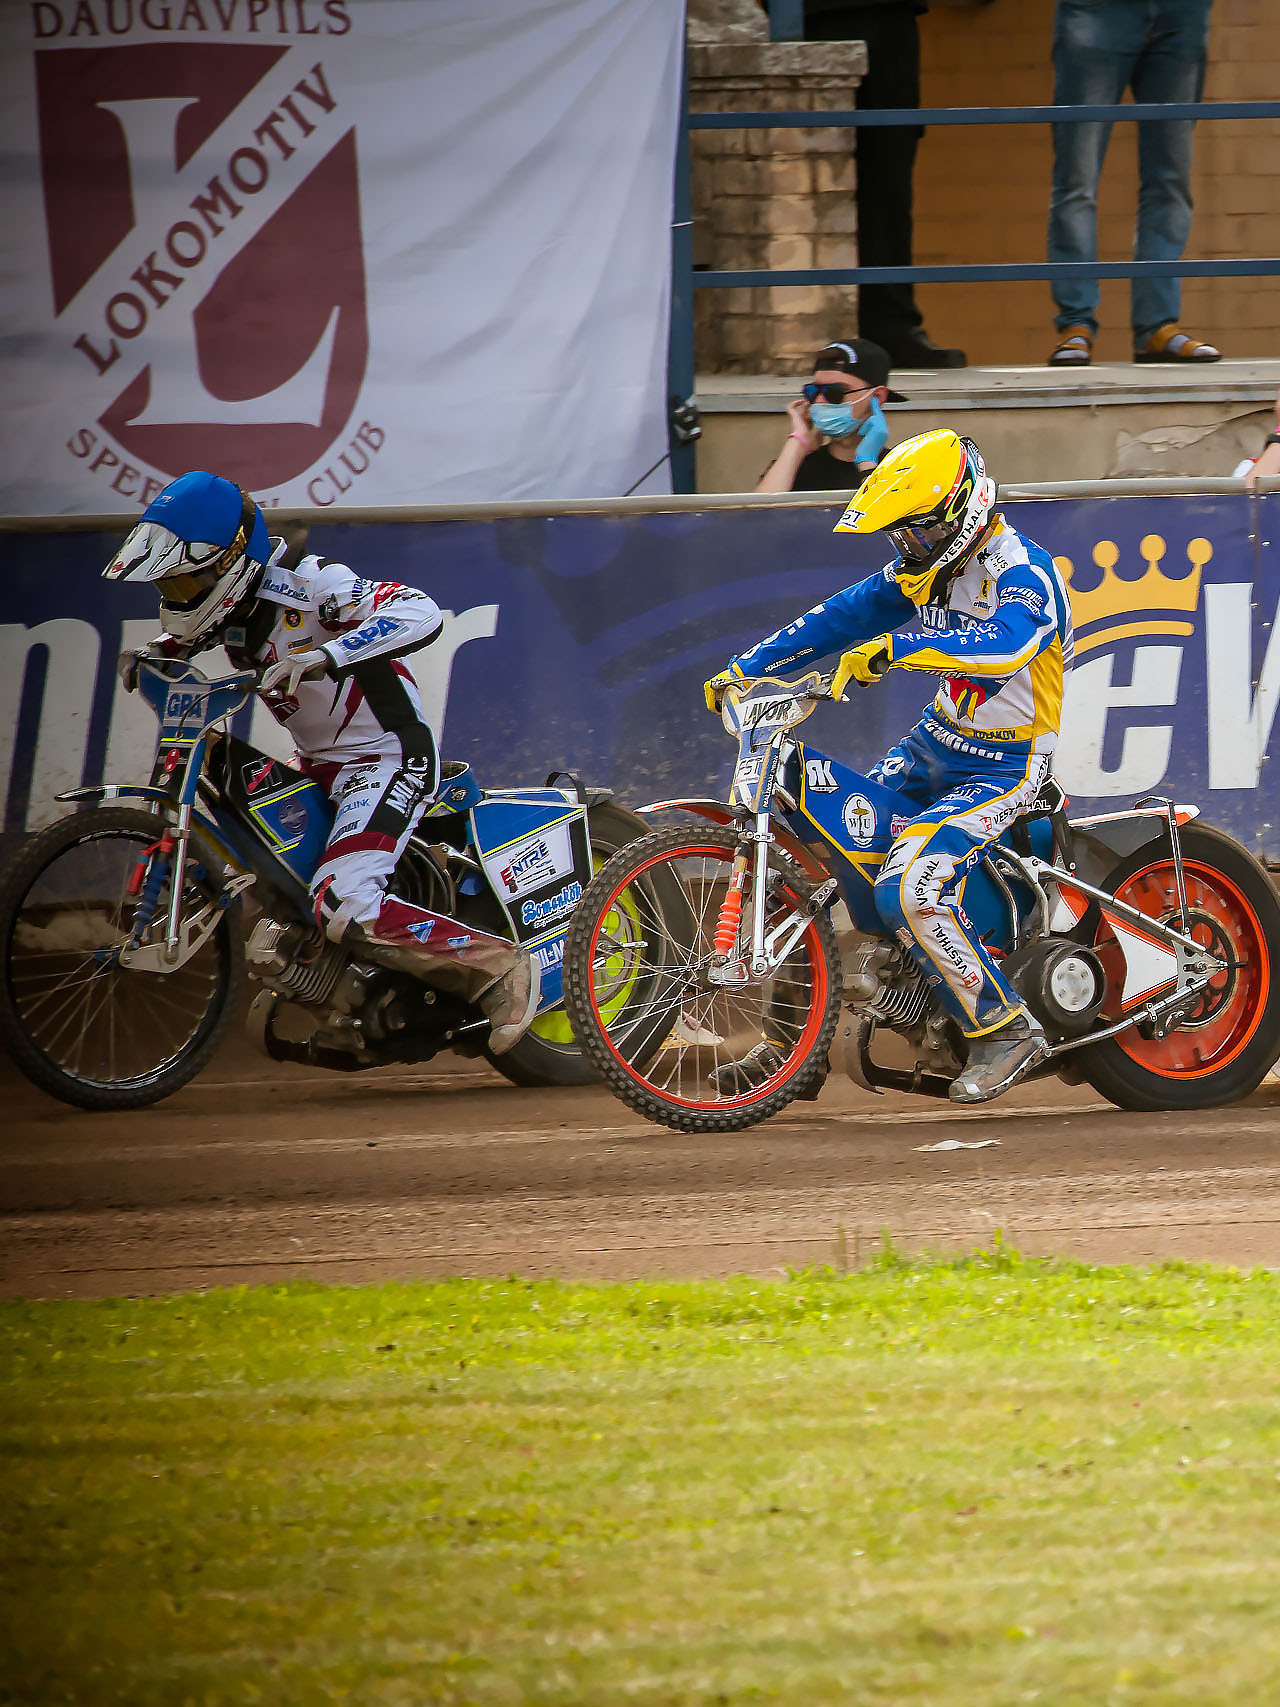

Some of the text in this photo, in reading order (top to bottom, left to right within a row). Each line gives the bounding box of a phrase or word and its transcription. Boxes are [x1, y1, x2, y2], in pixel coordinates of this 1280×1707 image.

[33, 0, 352, 38] DAUGAVPILS
[73, 62, 338, 376] LOKOMOTIV
[306, 420, 387, 507] CLUB
[940, 507, 984, 564] VESTHAL
[341, 617, 401, 651] GPA
[167, 691, 204, 719] GPA
[931, 922, 969, 975] VESTHAL
